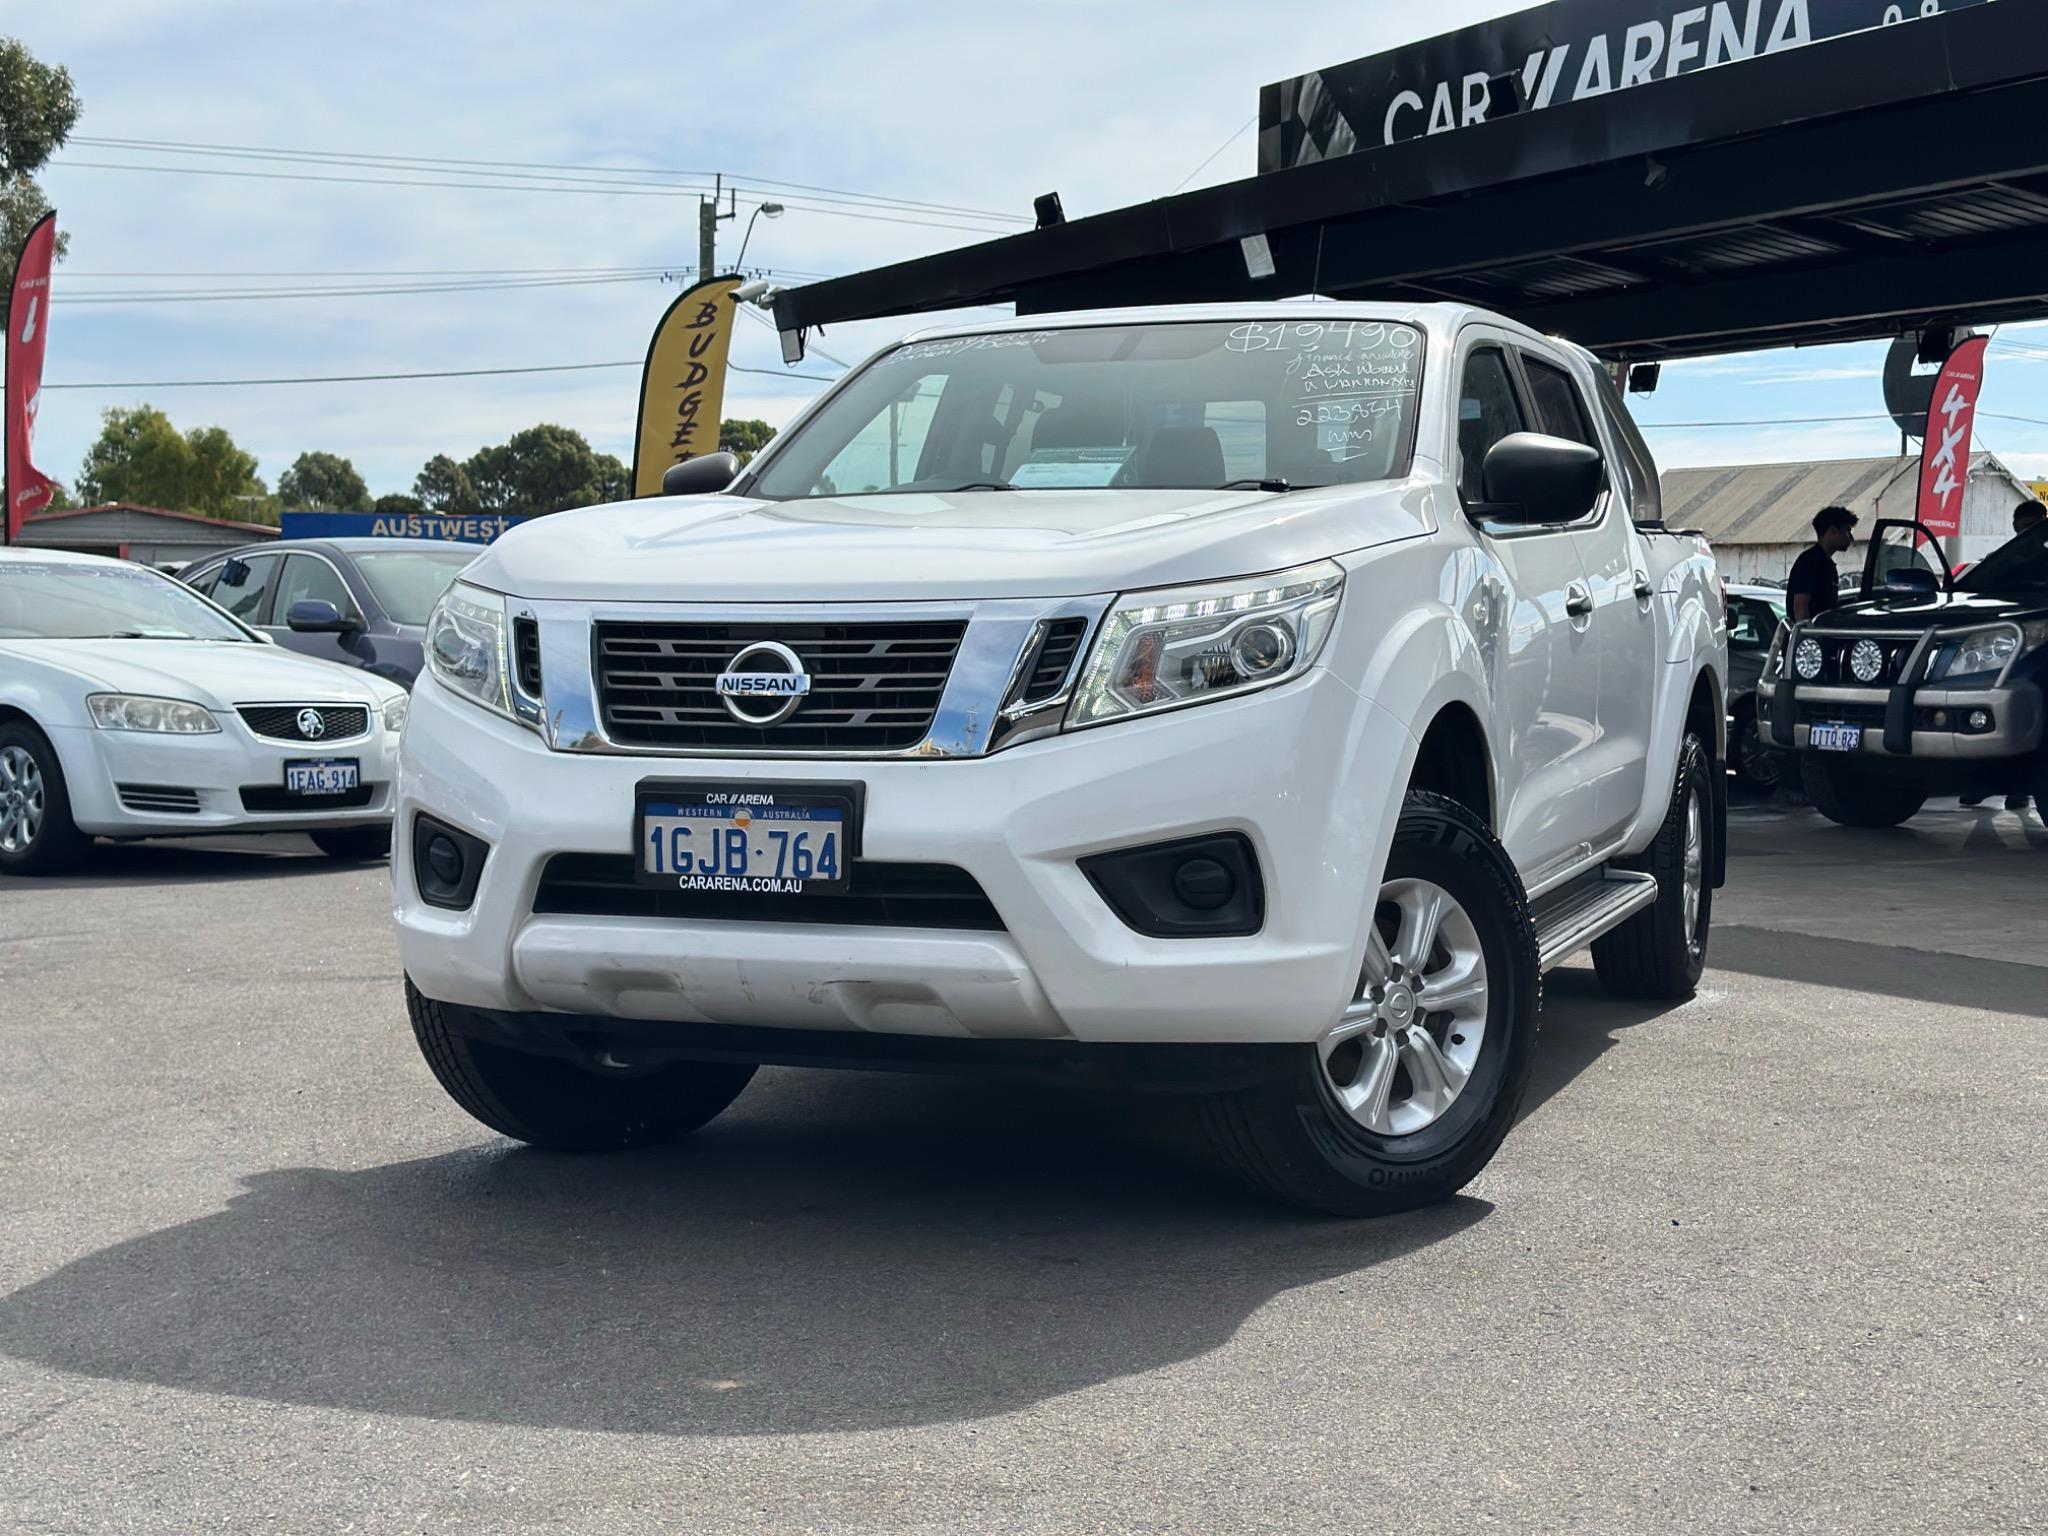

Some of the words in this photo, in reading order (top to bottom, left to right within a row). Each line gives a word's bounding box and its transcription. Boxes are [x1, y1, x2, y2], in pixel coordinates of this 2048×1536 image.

[1384, 72, 1491, 146] CAR
[1572, 0, 1811, 100] ARENA
[371, 517, 509, 538] AUSTWEST
[721, 678, 797, 691] NISSAN
[706, 793, 728, 804] CAR
[738, 795, 774, 806] ARENA
[677, 808, 722, 817] WESTERN
[762, 810, 811, 820] AUSTRALIA
[679, 875, 803, 893] CARARENA.COM.AU
